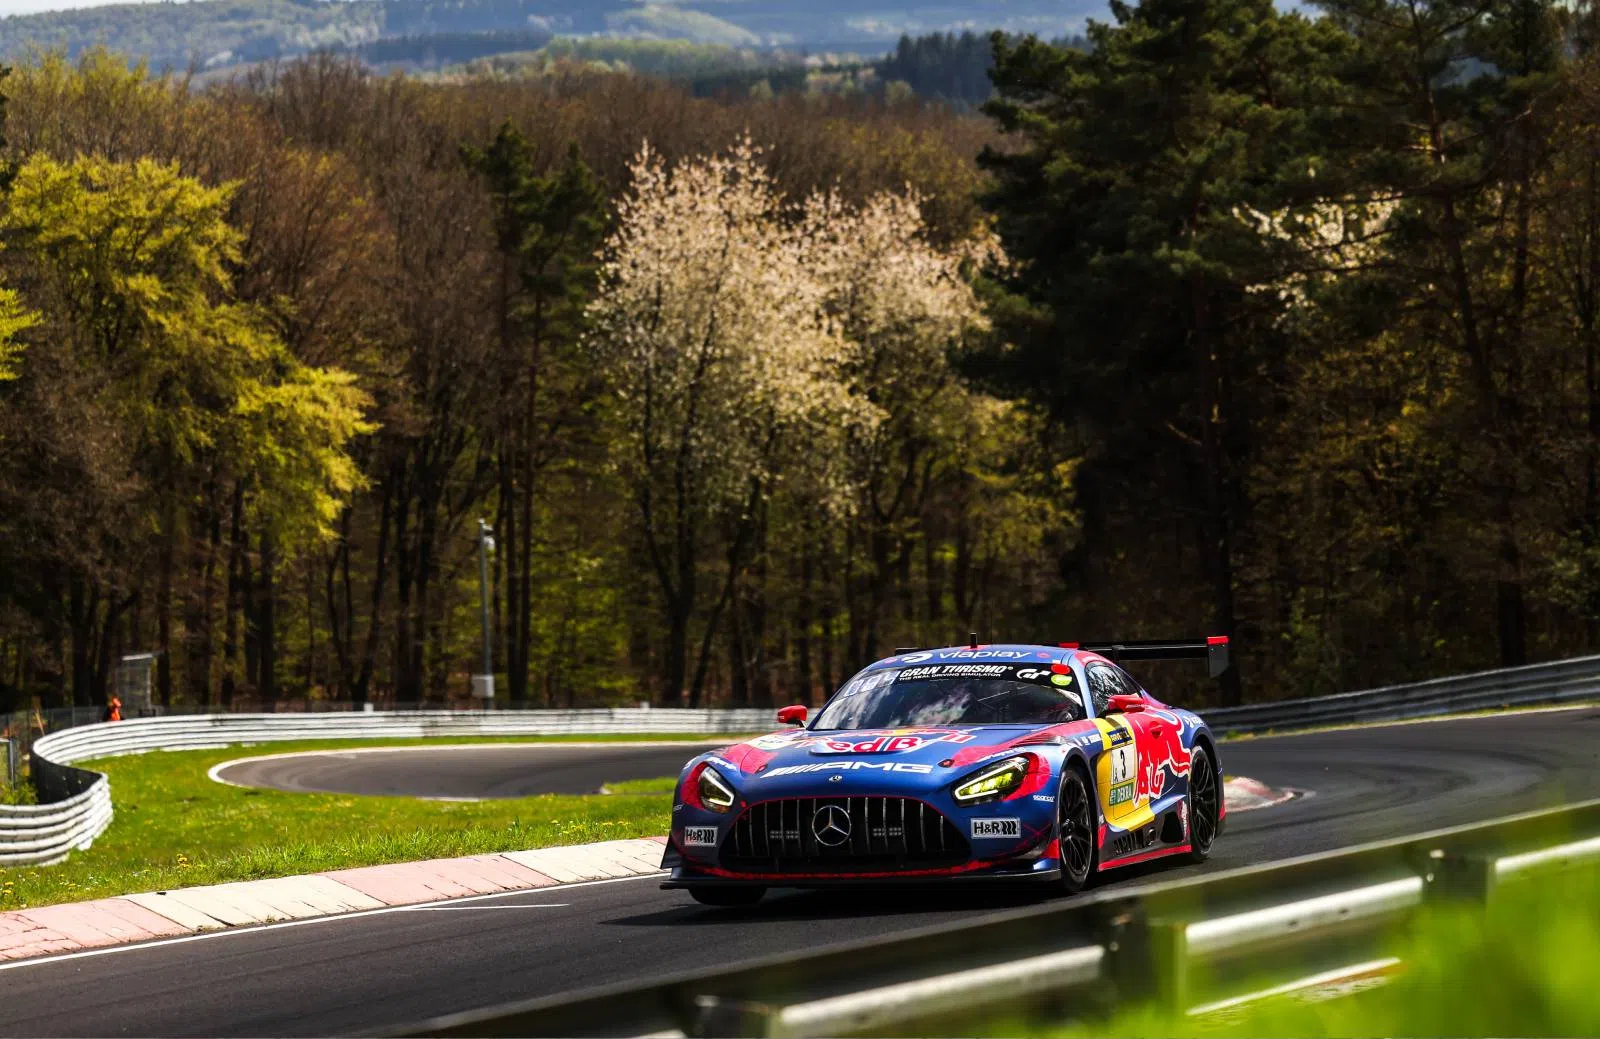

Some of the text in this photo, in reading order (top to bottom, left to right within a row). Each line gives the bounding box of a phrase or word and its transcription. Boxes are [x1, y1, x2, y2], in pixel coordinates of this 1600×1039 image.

[939, 651, 1031, 659] viaplay
[900, 665, 942, 677] GRAN
[811, 761, 934, 774] AMG
[1120, 749, 1126, 779] 3
[1117, 785, 1133, 803] DEKRA
[973, 821, 1001, 835] H&R
[686, 829, 703, 842] H&R
